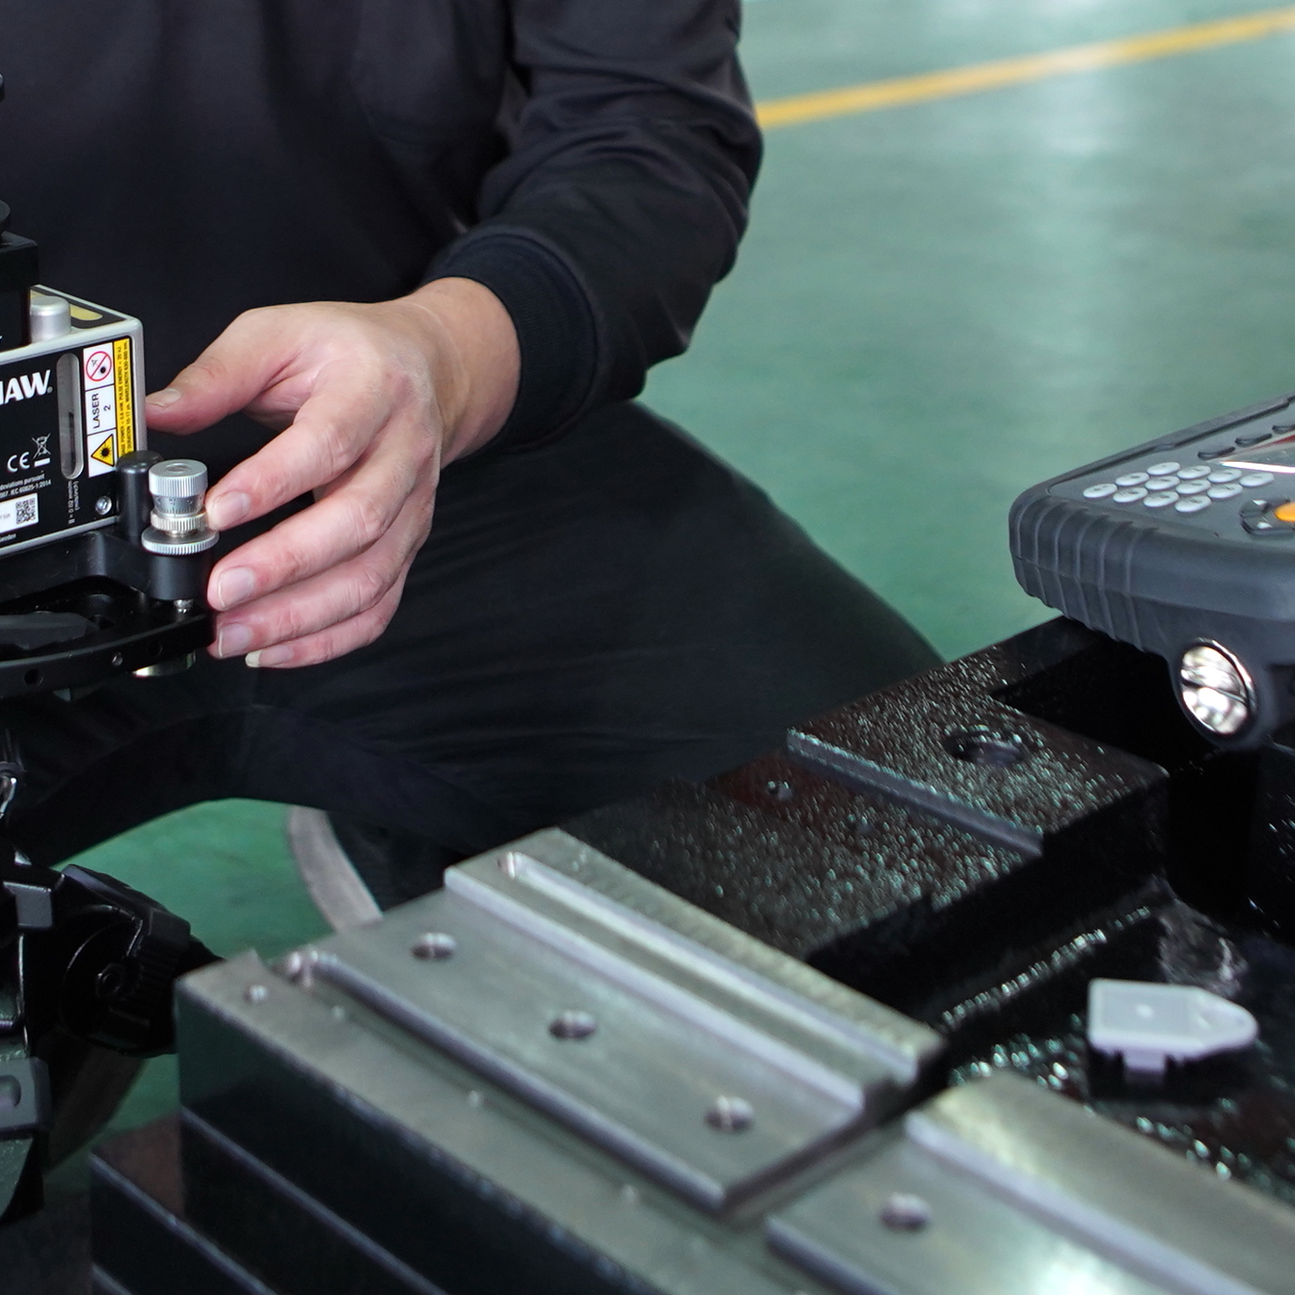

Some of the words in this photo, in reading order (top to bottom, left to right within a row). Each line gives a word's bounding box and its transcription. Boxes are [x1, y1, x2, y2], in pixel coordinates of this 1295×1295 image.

[91, 393, 101, 429] LASER
[7, 451, 30, 473] CE
[0, 479, 23, 490] deviations
[24, 474, 45, 485] pursuant
